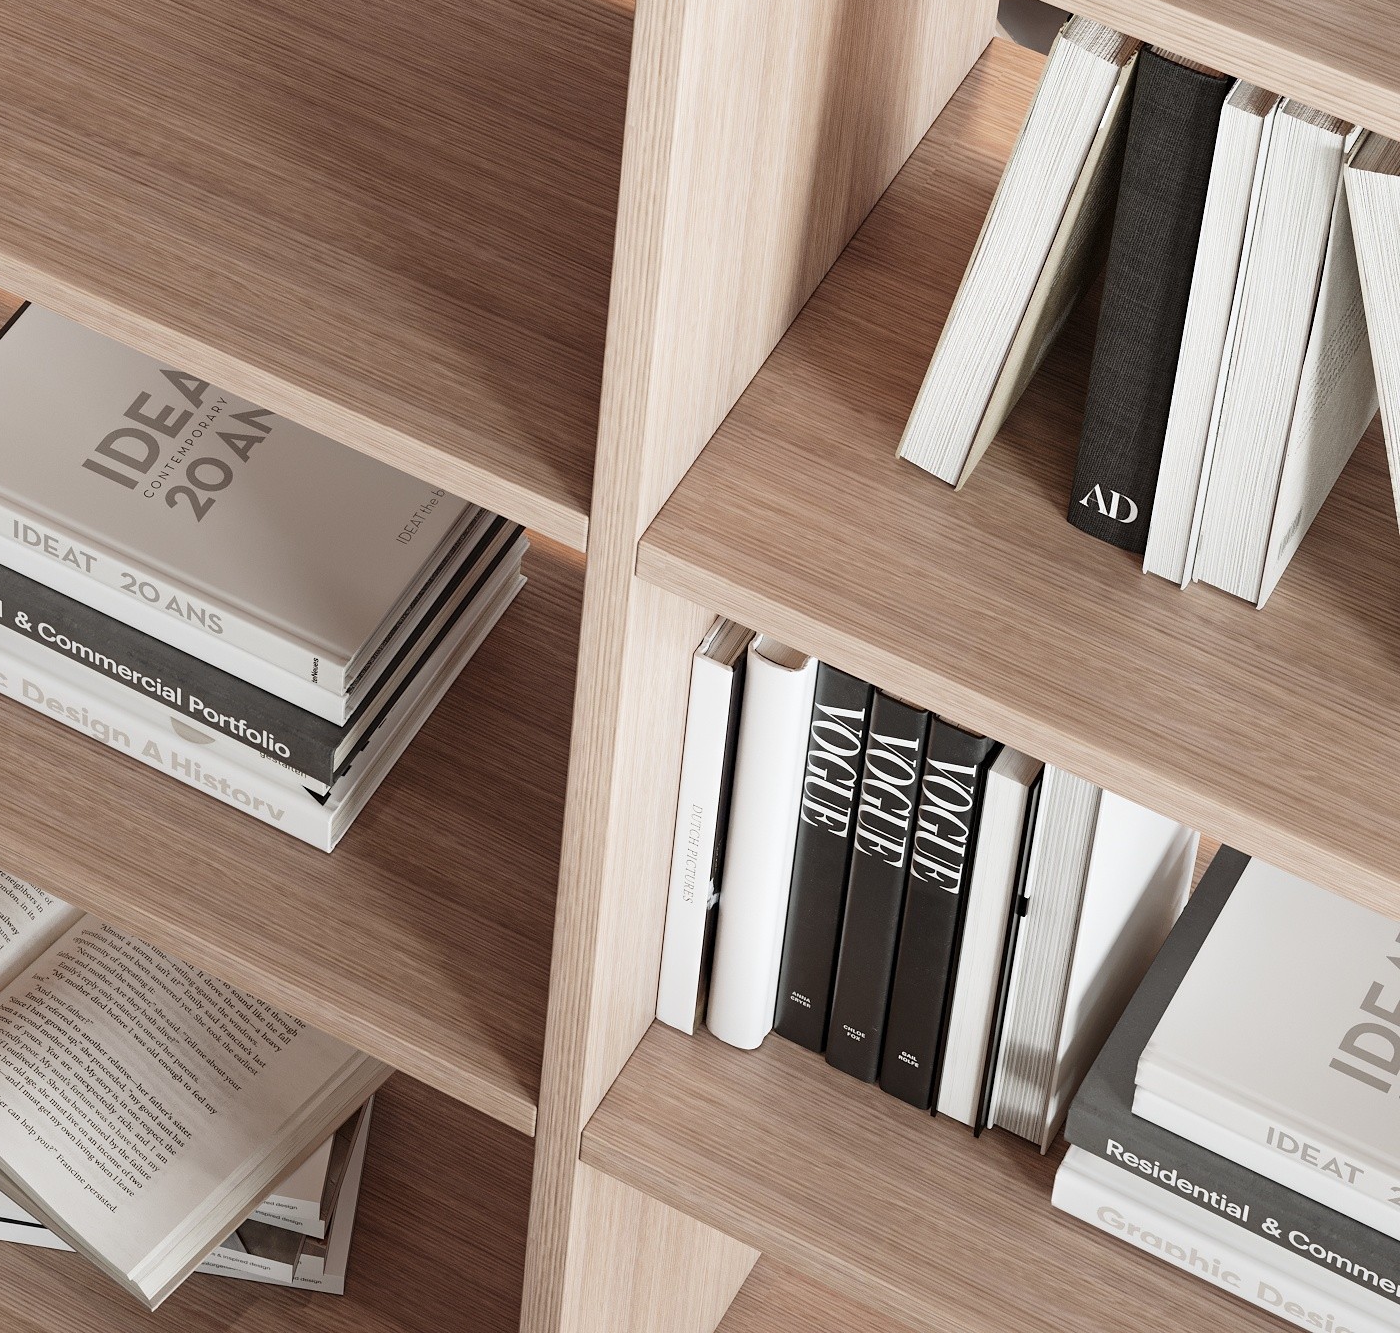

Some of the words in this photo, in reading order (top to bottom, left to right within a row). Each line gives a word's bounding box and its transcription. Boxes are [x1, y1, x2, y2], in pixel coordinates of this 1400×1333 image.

[143, 396, 229, 499] CONTEMPORARY
[165, 457, 234, 523] 20
[1079, 483, 1139, 524] AD
[396, 511, 426, 546] IDEAT
[13, 519, 98, 574] IDEAT
[120, 572, 160, 603] 20
[165, 595, 224, 635] ANS
[14, 611, 33, 633] &
[37, 622, 182, 706] Commercial
[189, 694, 291, 759] Portfolio
[22, 678, 131, 748] Design
[141, 741, 164, 765] A
[171, 751, 286, 821] History
[800, 702, 866, 838] VOGUE
[689, 804, 704, 847] DUTCH
[854, 730, 919, 868] VOGUE
[910, 757, 978, 895] VOGUE
[682, 844, 699, 905] PICTURES
[791, 990, 812, 1004] ANNA
[843, 1023, 866, 1039] CHLOE
[846, 1031, 861, 1042] FOX
[900, 1050, 918, 1064] GAIL
[898, 1055, 919, 1069] ROLFE
[56, 1153, 87, 1184] Francine
[84, 1183, 117, 1214] persisted.
[1266, 1126, 1364, 1185] IDEAT
[1106, 1138, 1250, 1223] Residential
[1261, 1217, 1282, 1240] &
[1096, 1205, 1242, 1290] Graphic
